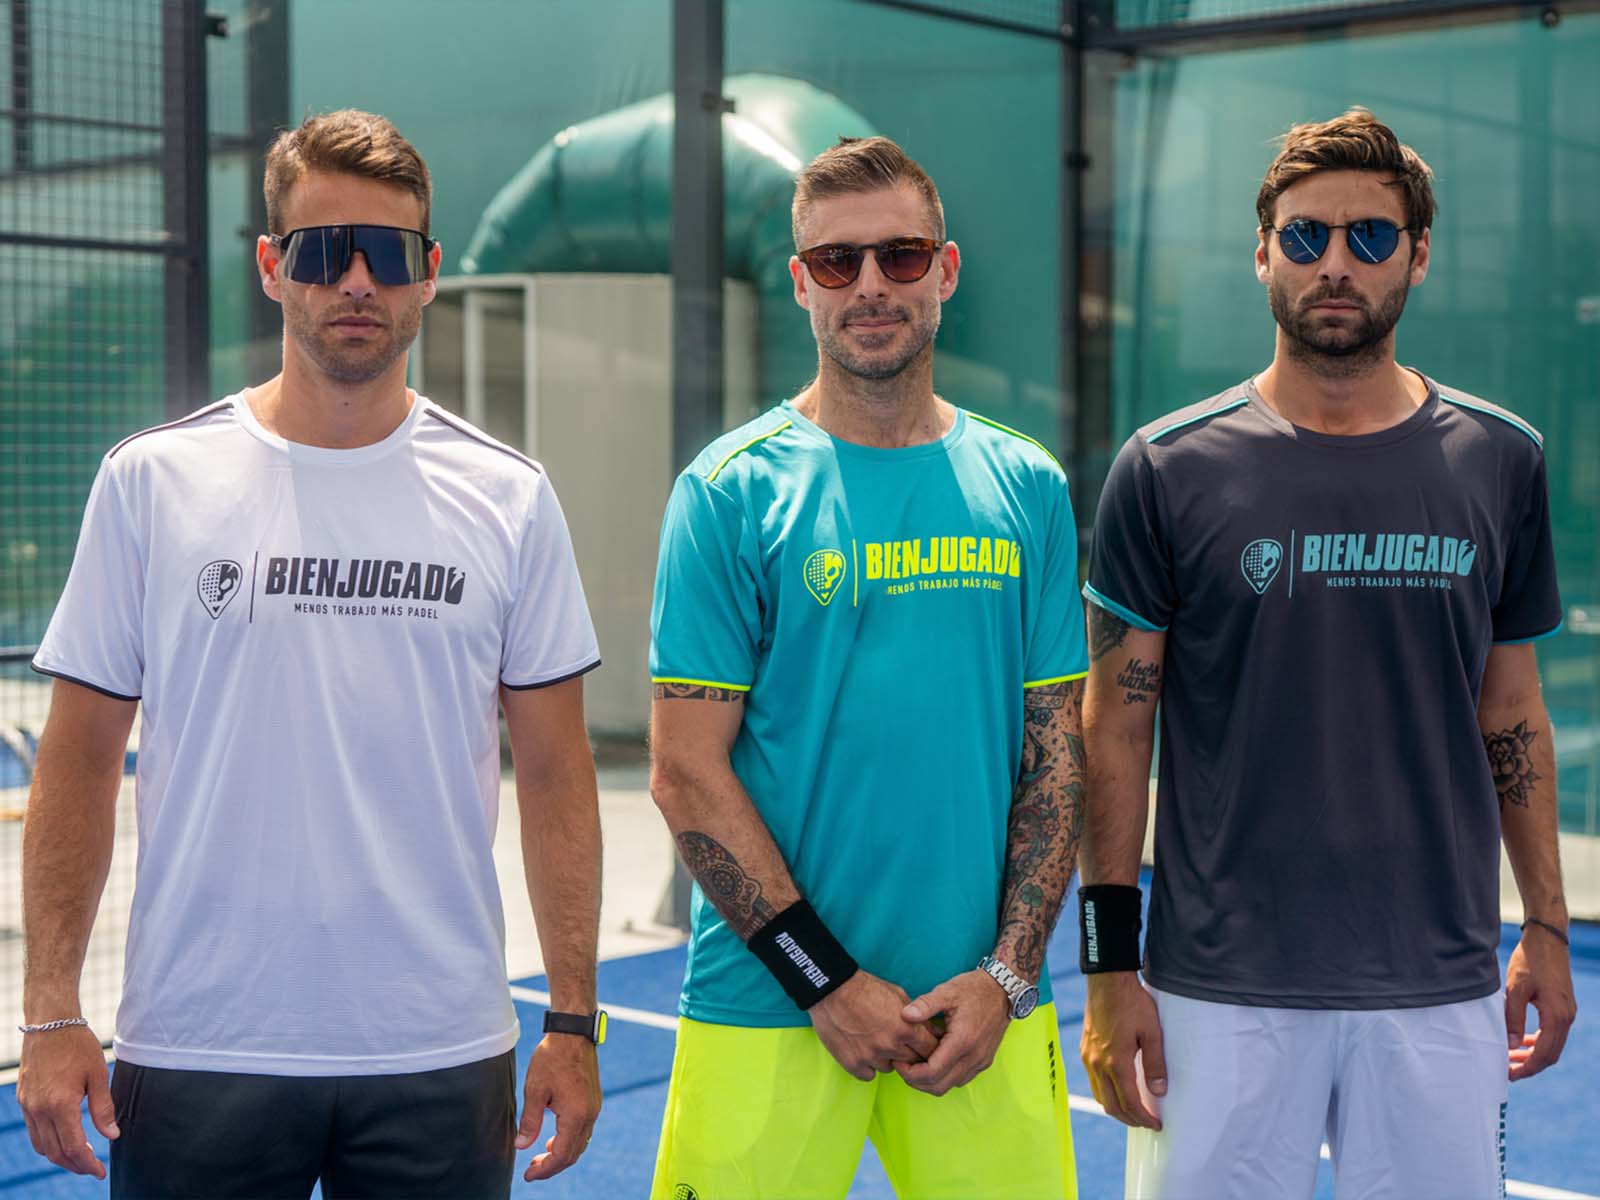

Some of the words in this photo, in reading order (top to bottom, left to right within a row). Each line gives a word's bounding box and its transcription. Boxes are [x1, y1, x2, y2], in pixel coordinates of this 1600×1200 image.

[1302, 534, 1477, 576] BIENJUGADO
[265, 557, 466, 605] BIENJUGADO
[887, 582, 915, 595] MENOS
[918, 578, 959, 590] TRABAJO
[962, 576, 981, 589] MÁS
[1327, 577, 1356, 588] MENOS
[1360, 577, 1402, 588] TRABAJO
[1406, 575, 1426, 588] MÁS
[294, 603, 328, 615] MENOS
[333, 605, 377, 616] TRABAJO
[382, 604, 403, 616] MÁS
[775, 931, 830, 989] BIENJUGADO
